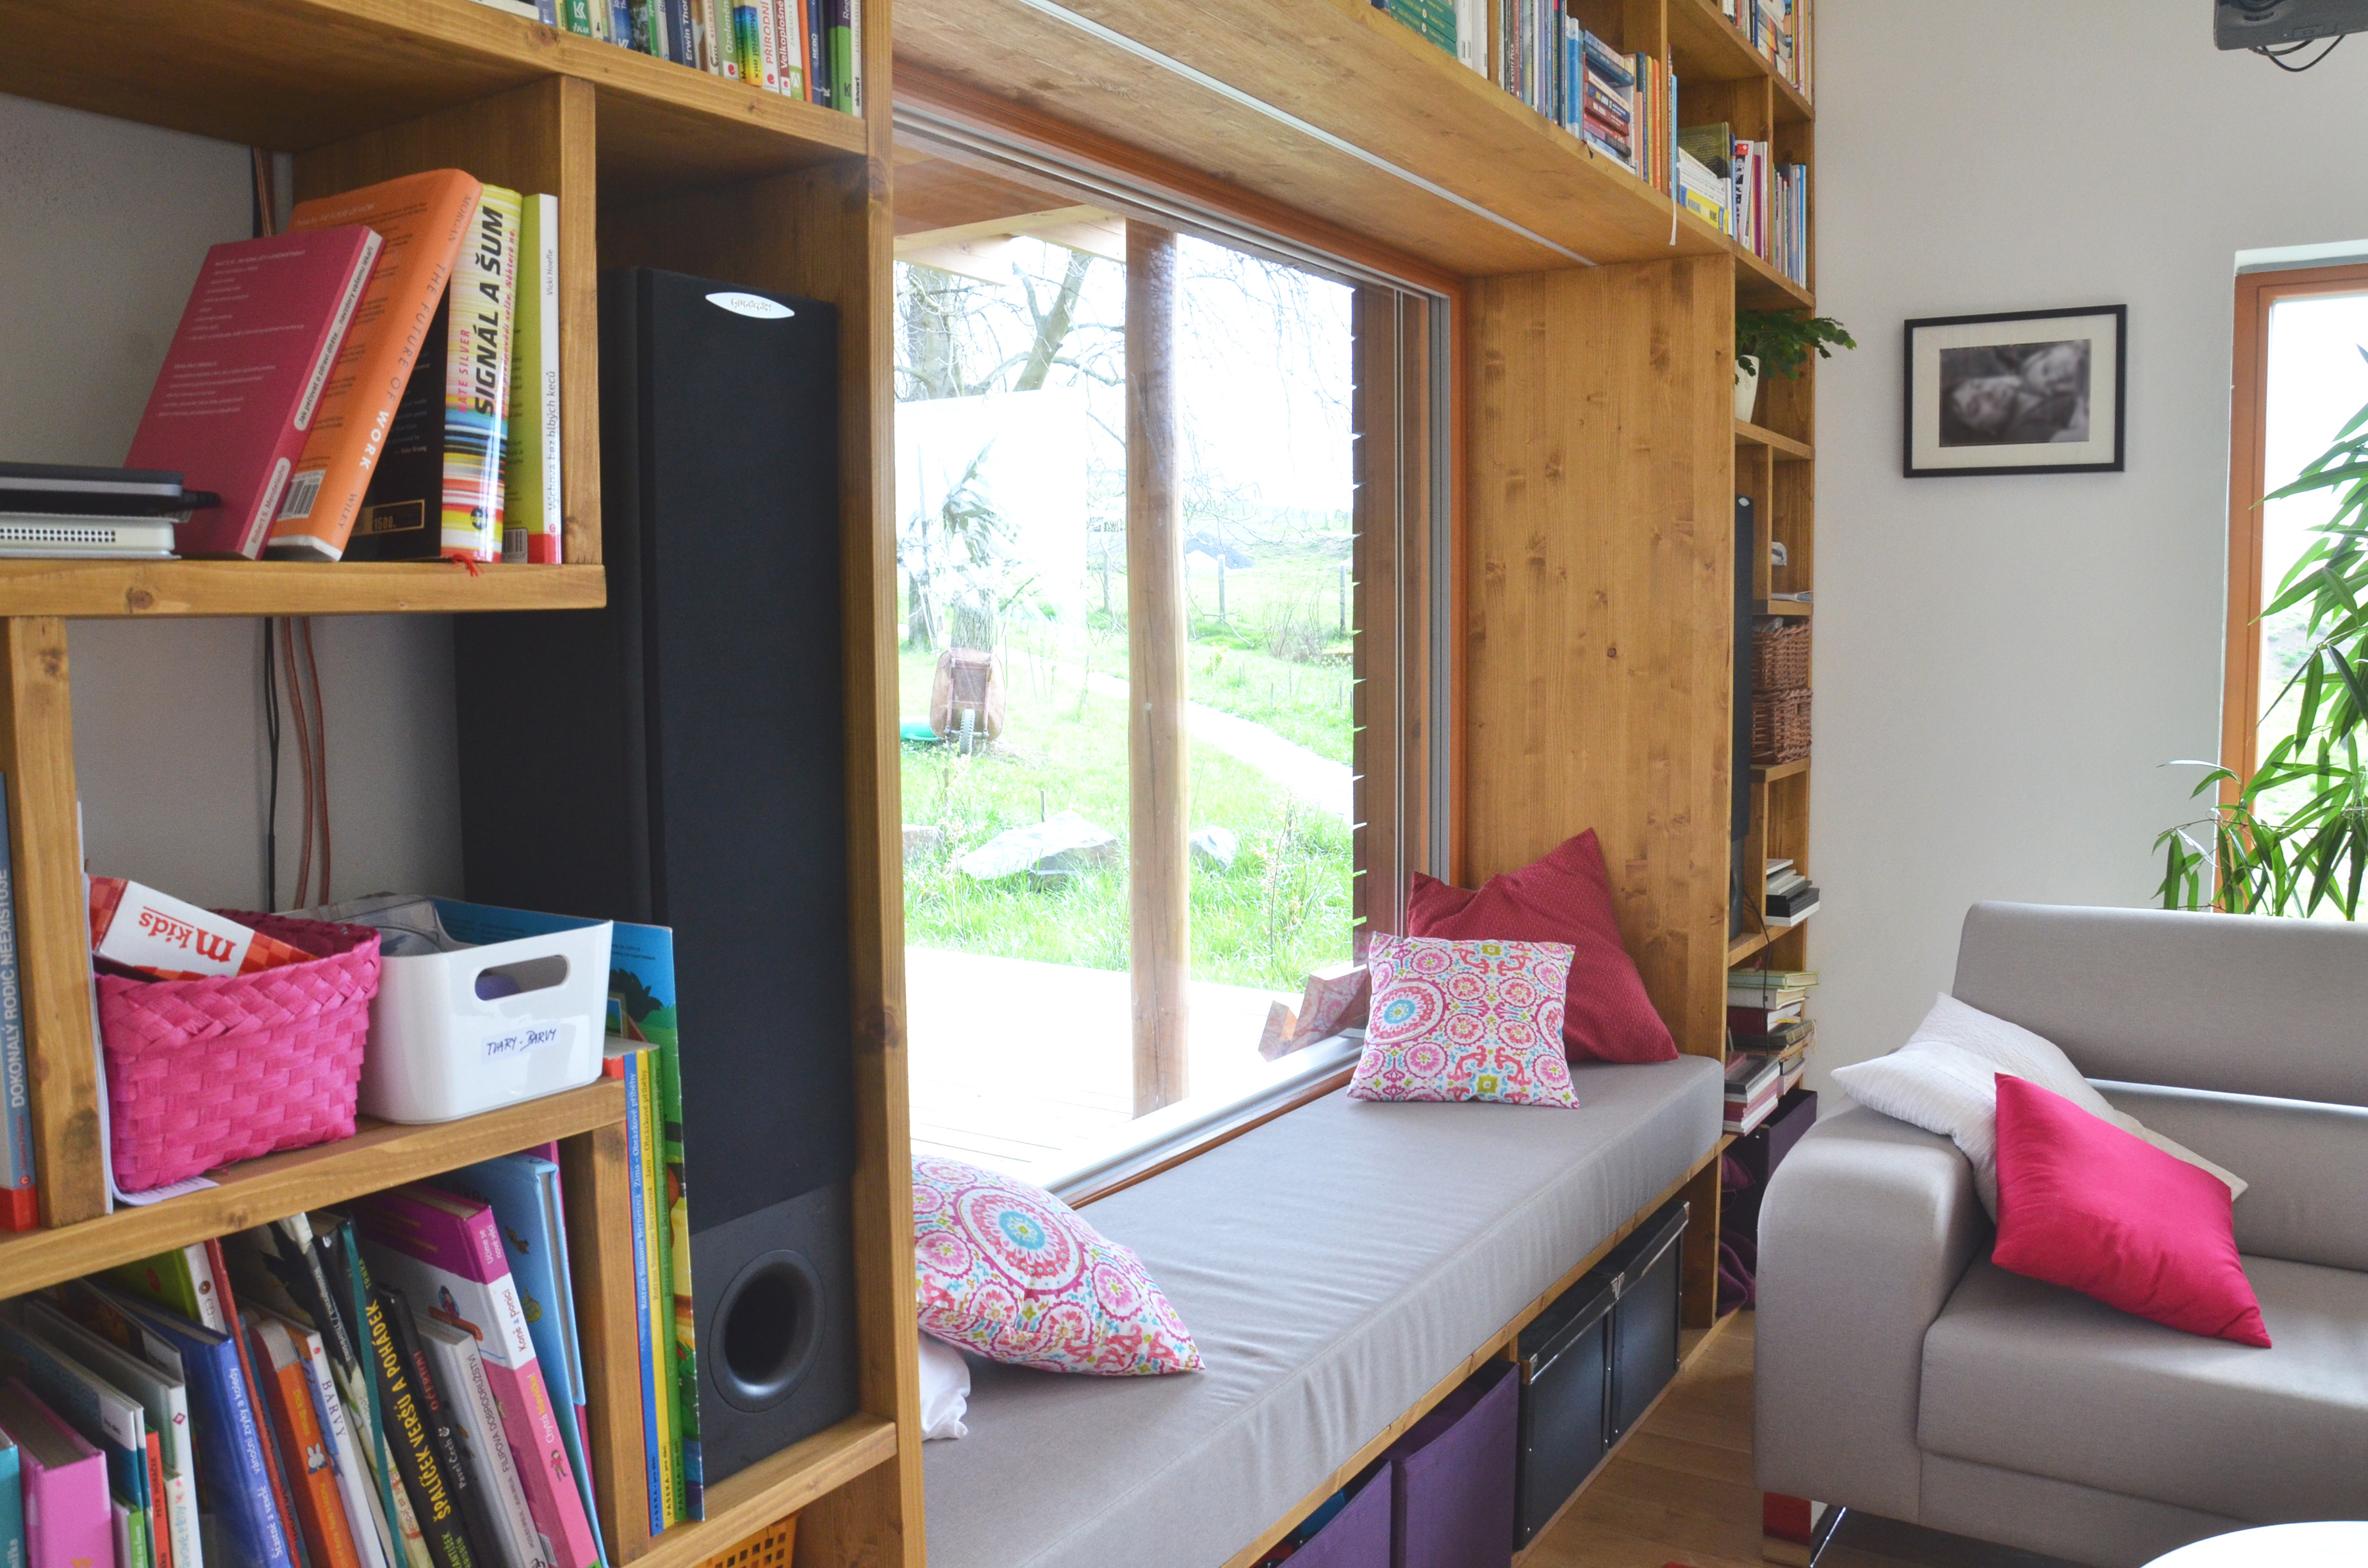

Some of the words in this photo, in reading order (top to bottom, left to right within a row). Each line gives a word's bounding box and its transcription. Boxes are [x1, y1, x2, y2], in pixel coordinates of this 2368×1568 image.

[684, 29, 693, 60] Erwin
[761, 1, 773, 63] PŘÍRODNÍ
[448, 193, 471, 241] MORGAN
[475, 205, 503, 276] ŠUM
[427, 263, 445, 295] THE
[505, 247, 514, 288] Některé
[480, 282, 500, 304] A
[299, 408, 308, 425] Jak
[305, 381, 319, 411] pečovat
[318, 350, 330, 377] zdraví
[338, 291, 356, 324] navzdory
[352, 266, 365, 294] vašemu
[362, 246, 372, 267] lékaři
[399, 302, 430, 368] FUTURE
[459, 329, 470, 374] SILVER
[473, 311, 498, 418] SIGNÁL
[387, 377, 400, 401] OF
[457, 382, 468, 414] NATE
[546, 371, 555, 396] keců
[547, 398, 559, 437] blbých
[359, 411, 390, 470] WORK
[547, 440, 555, 461] bez
[548, 464, 559, 510] Výchova
[251, 517, 266, 544] Robert
[265, 465, 286, 509] Mendelsohn
[338, 493, 358, 530] WILEY
[487, 1036, 518, 1056] TVARY
[522, 1029, 557, 1048] BARVY
[1, 1025, 25, 1108] DOKONALÝ
[629, 1074, 637, 1107] příběhy
[631, 1109, 639, 1156] Obrázkové
[479, 1229, 486, 1237] se
[487, 1224, 496, 1240] věci
[481, 1237, 493, 1264] Učíme
[491, 1240, 502, 1259] nové
[204, 1298, 215, 1315] CD
[502, 1289, 520, 1318] poníci
[366, 1300, 401, 1378] POHÁDEK
[512, 1326, 527, 1352] Koně
[229, 1367, 243, 1398] koledy
[393, 1376, 407, 1394] A
[466, 1353, 500, 1430] DOBRODRUŽSTVÍ
[526, 1372, 548, 1414] hlavička!
[237, 1399, 242, 1407] a
[322, 1379, 347, 1437] BARVY
[397, 1392, 425, 1446] VERŠŮ
[240, 1409, 255, 1441] zvyky
[299, 1406, 311, 1436] Bruna
[536, 1412, 555, 1444] Chytrá
[247, 1439, 261, 1475] vánoční
[442, 1437, 459, 1469] Čech
[489, 1429, 512, 1473] FILIPOVA
[418, 1450, 452, 1524] ŠPALÍČEK
[450, 1467, 467, 1490] Pavel
[258, 1485, 272, 1513] veselé
